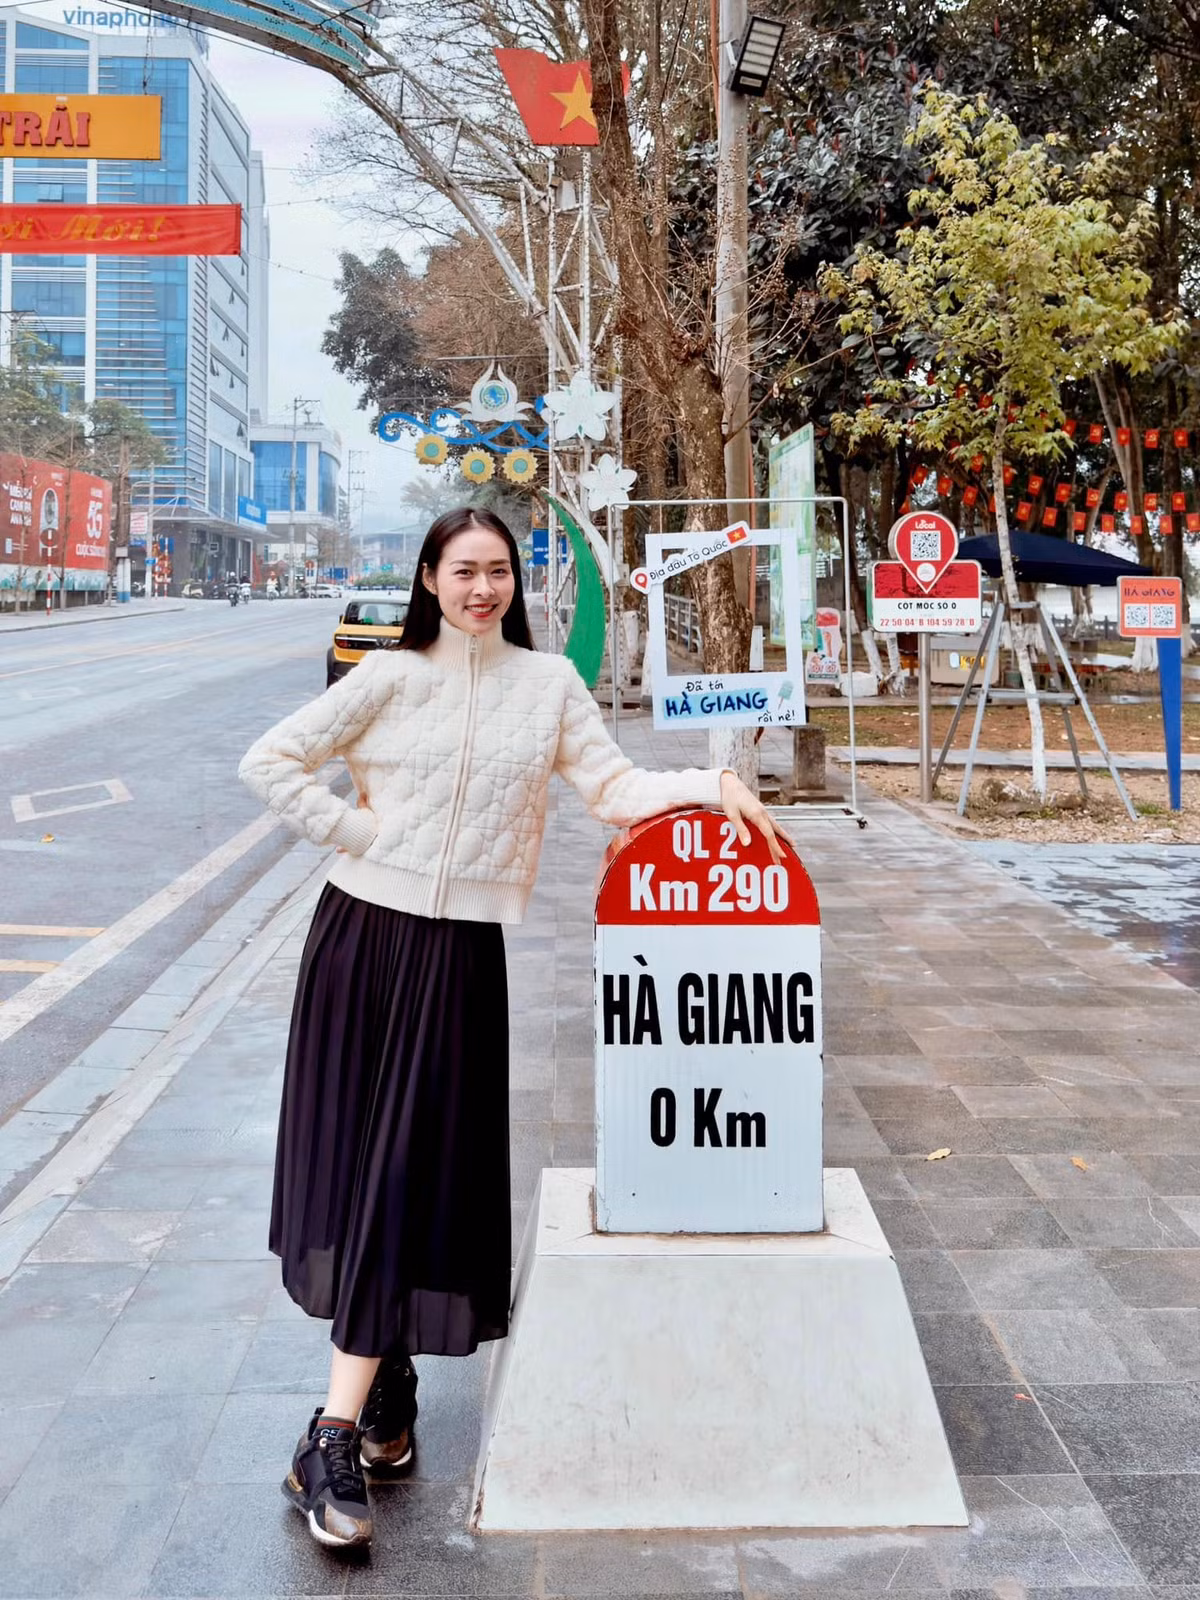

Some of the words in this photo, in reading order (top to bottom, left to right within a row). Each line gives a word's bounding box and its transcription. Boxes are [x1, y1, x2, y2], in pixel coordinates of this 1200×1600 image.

[665, 691, 692, 717] HÀ
[700, 691, 768, 714] GIANG
[685, 681, 703, 692] Đã
[709, 680, 724, 691] tới
[758, 710, 773, 723] rồi
[672, 819, 710, 863] QL
[719, 821, 738, 860] 2
[629, 863, 699, 912] Km
[707, 864, 789, 913] 290
[603, 954, 662, 1045] HÀ
[677, 972, 815, 1046] GIANG
[650, 1087, 677, 1148] 0
[693, 1087, 767, 1148] Km
